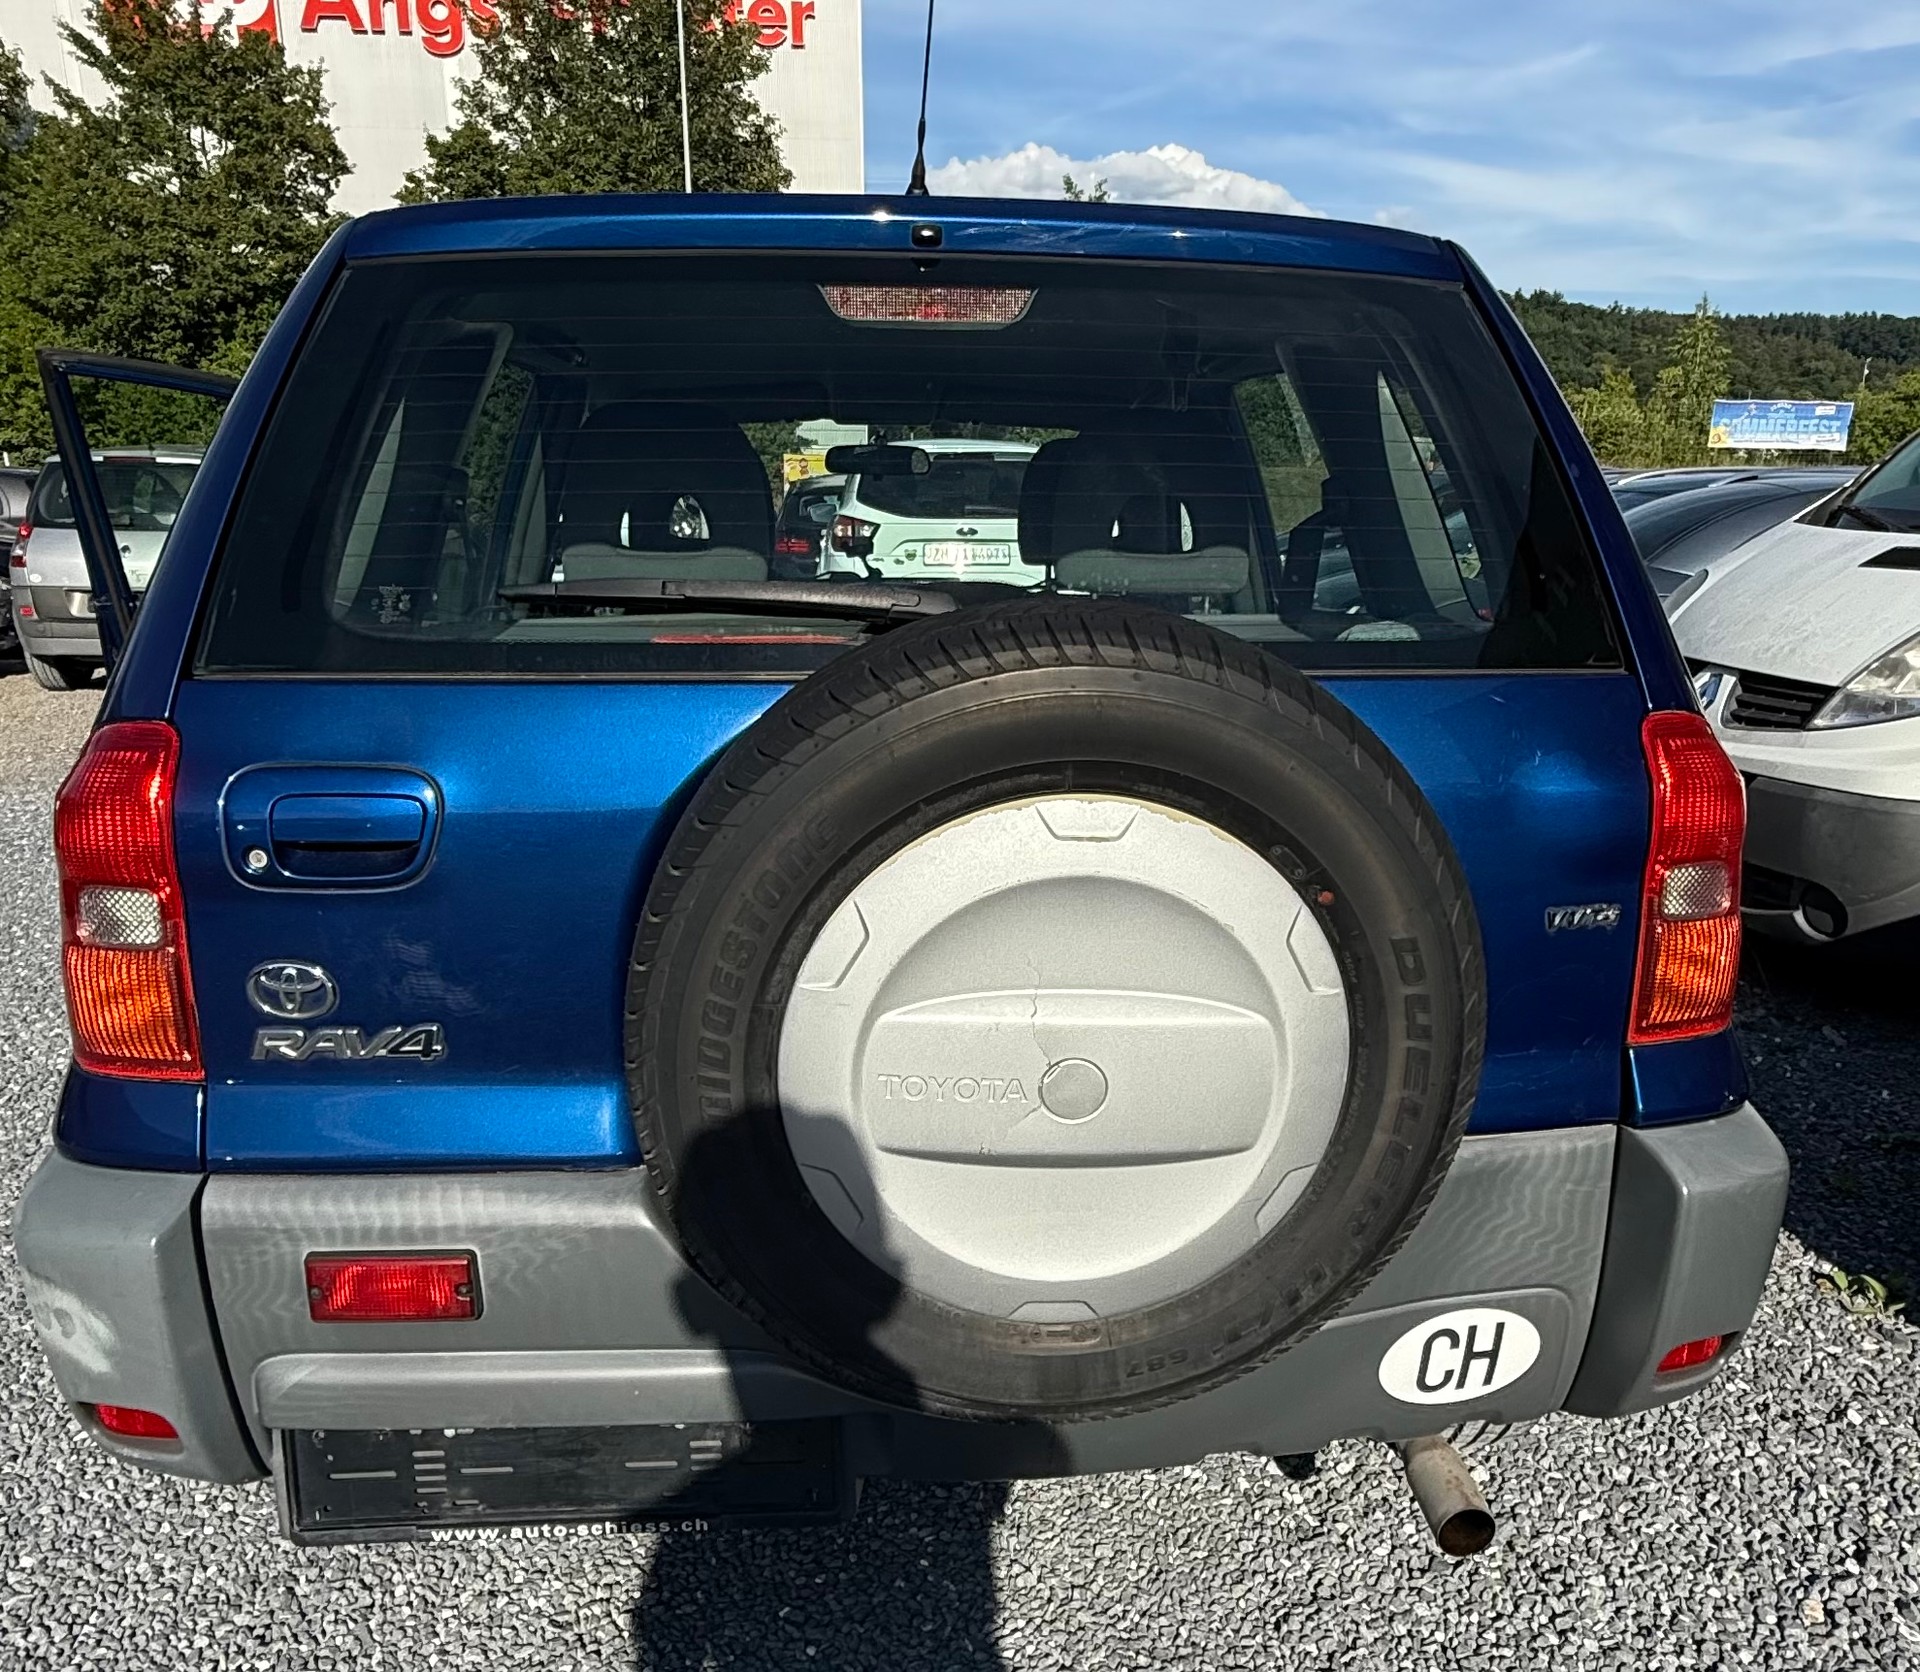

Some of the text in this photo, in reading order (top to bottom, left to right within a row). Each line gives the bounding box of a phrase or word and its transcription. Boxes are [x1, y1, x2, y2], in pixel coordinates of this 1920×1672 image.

[251, 1023, 446, 1061] RAV4
[877, 1073, 1029, 1104] TOYOTA
[1416, 1321, 1505, 1393] CH
[431, 1518, 709, 1542] www.auto-schiess.ch
